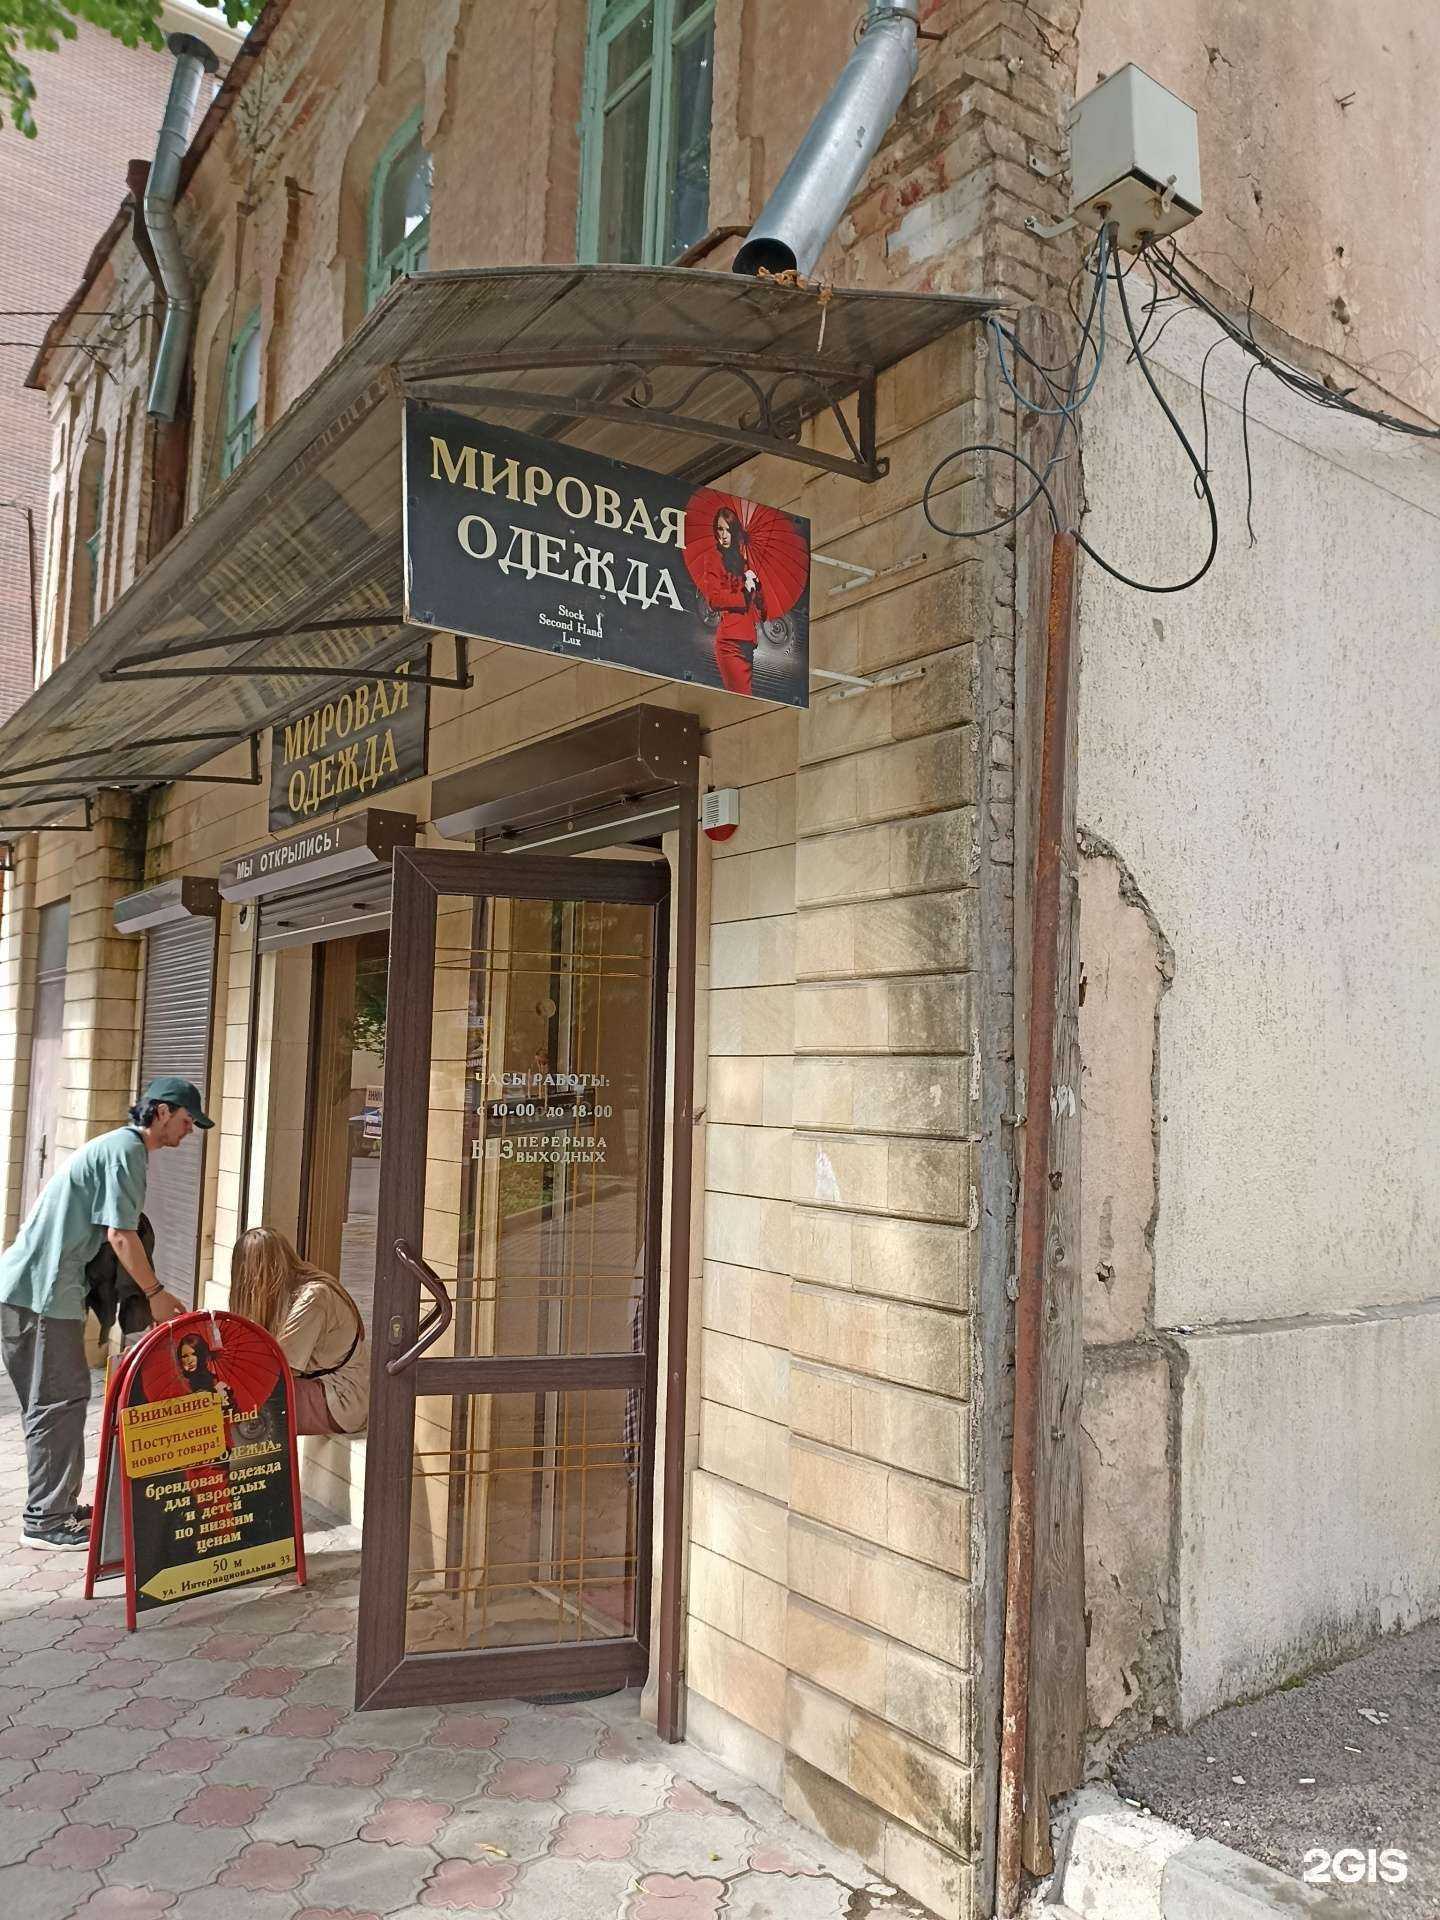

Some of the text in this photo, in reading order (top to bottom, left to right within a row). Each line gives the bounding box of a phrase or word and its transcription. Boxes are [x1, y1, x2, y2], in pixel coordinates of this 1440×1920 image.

[429, 436, 688, 550] МИРОВАЯ
[457, 515, 685, 611] ОДЕЖДА
[539, 613, 603, 638] Second Hand
[558, 604, 585, 621] Stock
[562, 631, 582, 646] Lux
[283, 661, 411, 766] МИРОВАЯ
[288, 728, 399, 815] ОДЕЖДА
[236, 859, 253, 880] МЫ
[475, 1072, 610, 1087] ЧАСЫ РАБОТЫ:
[491, 1103, 535, 1117] 10-00
[546, 1106, 564, 1118] до
[571, 1104, 613, 1118] 18-00
[516, 1136, 607, 1148] ПЕРЕРЫВА
[516, 1151, 606, 1164] ВЫХОДНЫХ
[128, 1392, 217, 1426] Внимание!
[131, 1424, 218, 1453] Поступление
[131, 1451, 174, 1469] нового
[177, 1436, 220, 1456] товара!
[145, 1473, 224, 1500] брендовая
[229, 1461, 282, 1481] одежда
[164, 1479, 267, 1512] для взрослых
[201, 1496, 242, 1519] детей
[175, 1512, 254, 1540] по низким
[195, 1531, 241, 1553] ценам
[162, 1587, 177, 1599] ул.
[280, 1554, 291, 1567] 33
[213, 1557, 228, 1574] 50
